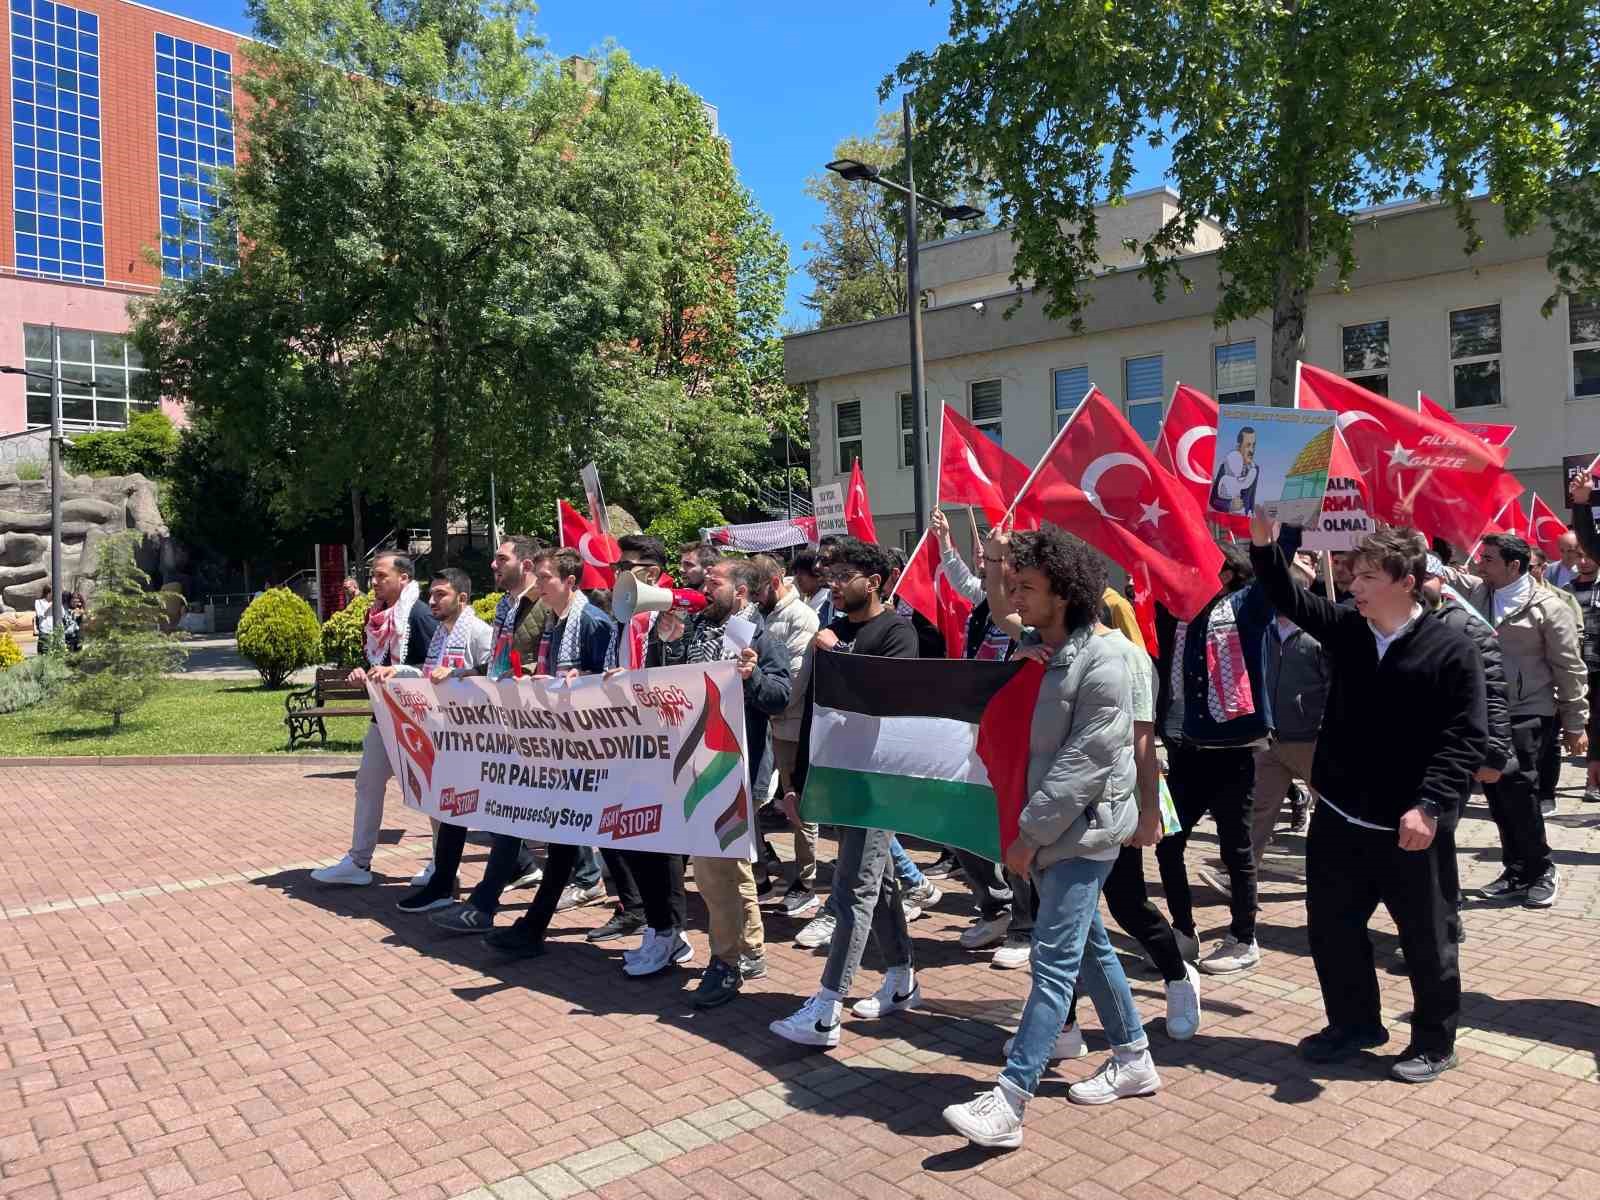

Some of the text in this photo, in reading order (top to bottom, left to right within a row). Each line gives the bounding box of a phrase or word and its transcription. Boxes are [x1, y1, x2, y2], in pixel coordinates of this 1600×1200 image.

[1408, 456, 1467, 469] GAZZE
[1326, 477, 1357, 491] ALM
[1323, 518, 1367, 532] OLMA!
[574, 706, 643, 731] UNITY
[480, 762, 507, 785] FOR
[619, 808, 658, 836] STOP!
